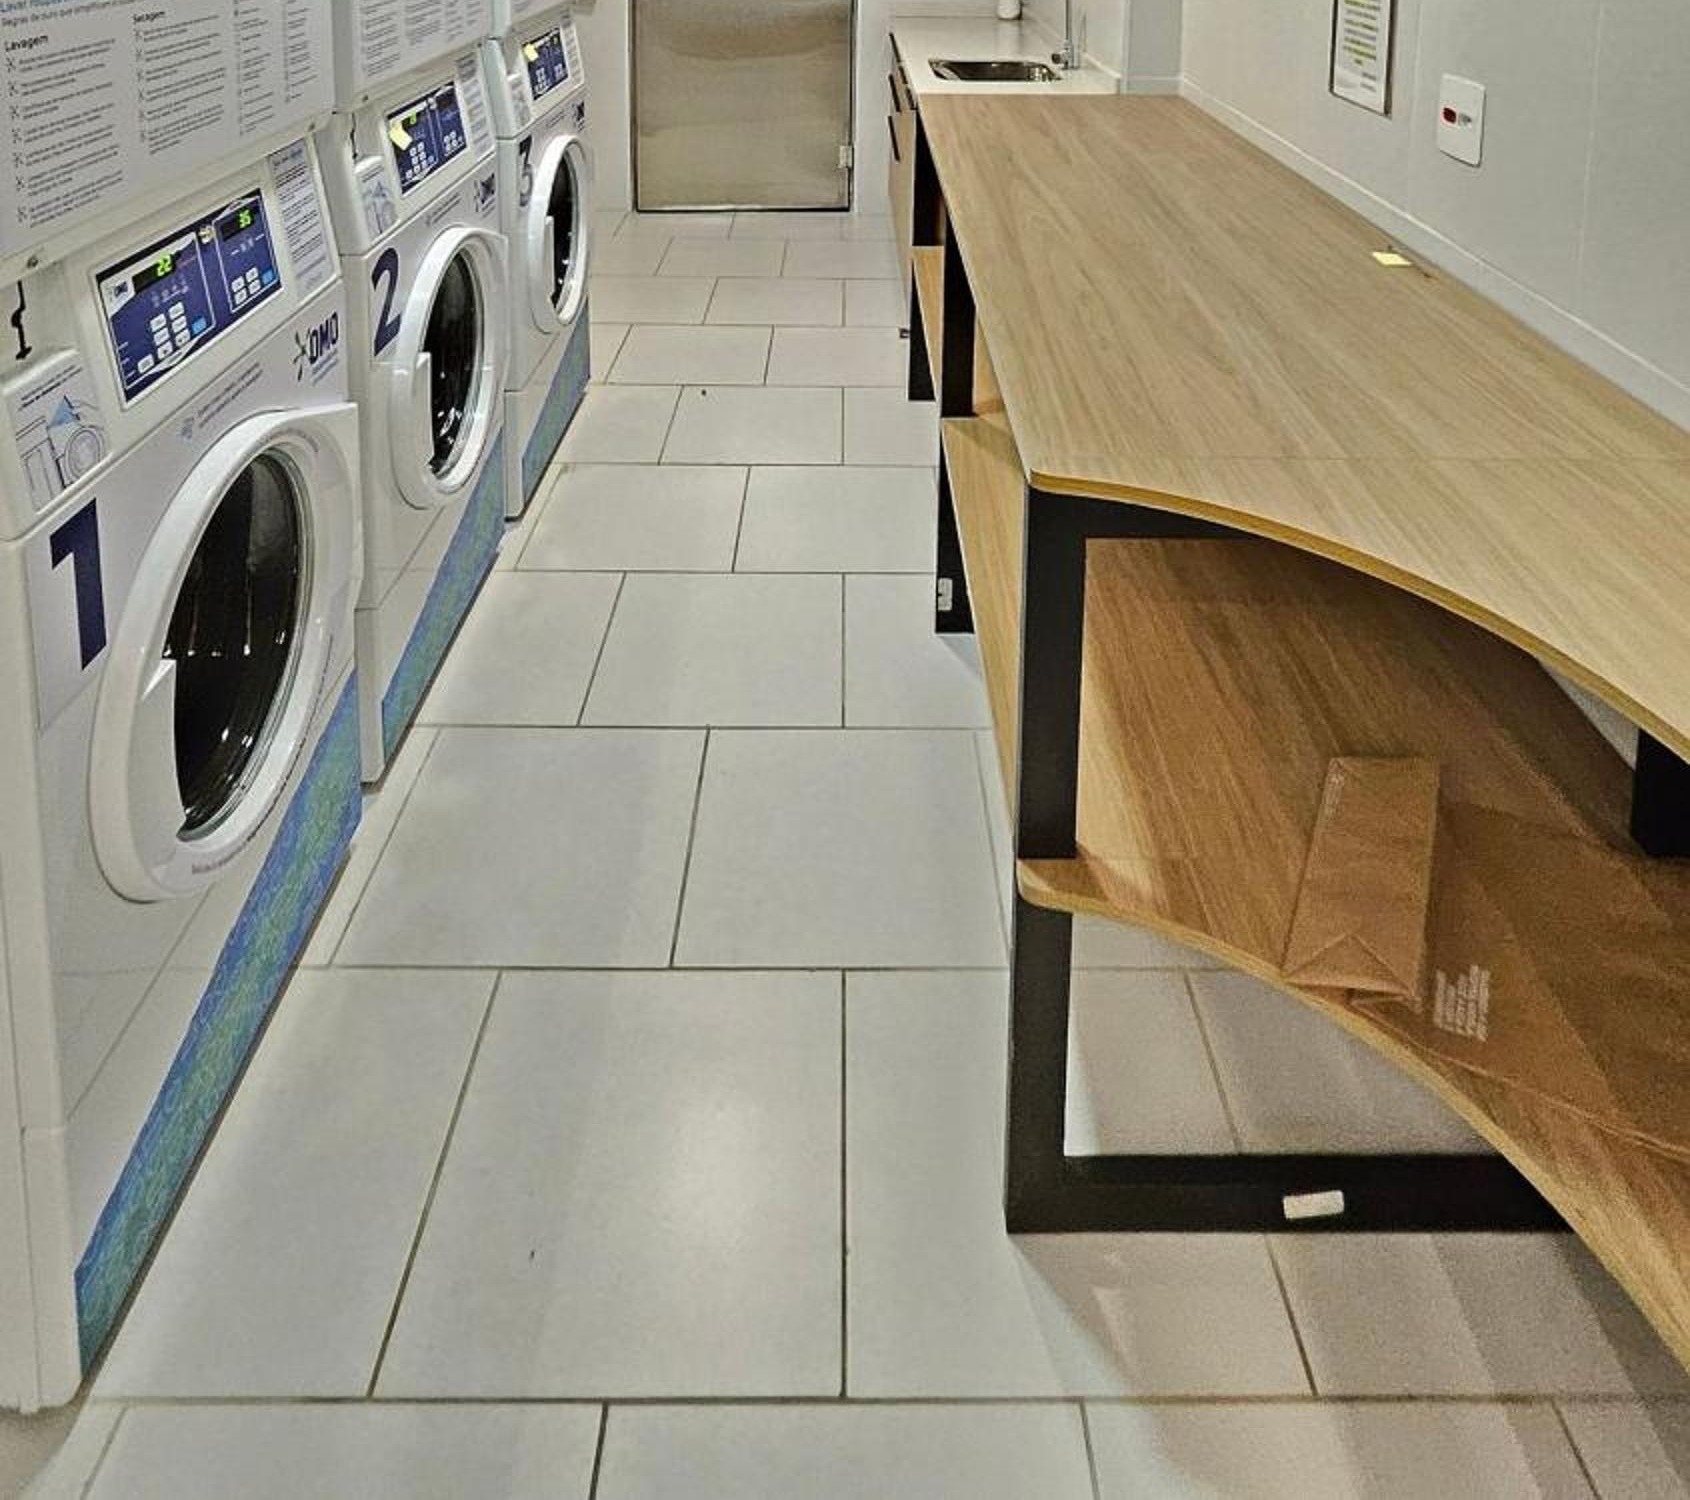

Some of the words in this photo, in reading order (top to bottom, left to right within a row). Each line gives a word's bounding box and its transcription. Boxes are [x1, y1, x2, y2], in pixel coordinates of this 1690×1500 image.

[5, 33, 48, 52] Lavagem
[133, 10, 165, 25] Secagem
[519, 134, 533, 207] 3
[371, 247, 400, 357] 2
[308, 311, 339, 365] OMO
[50, 498, 107, 671] 1
